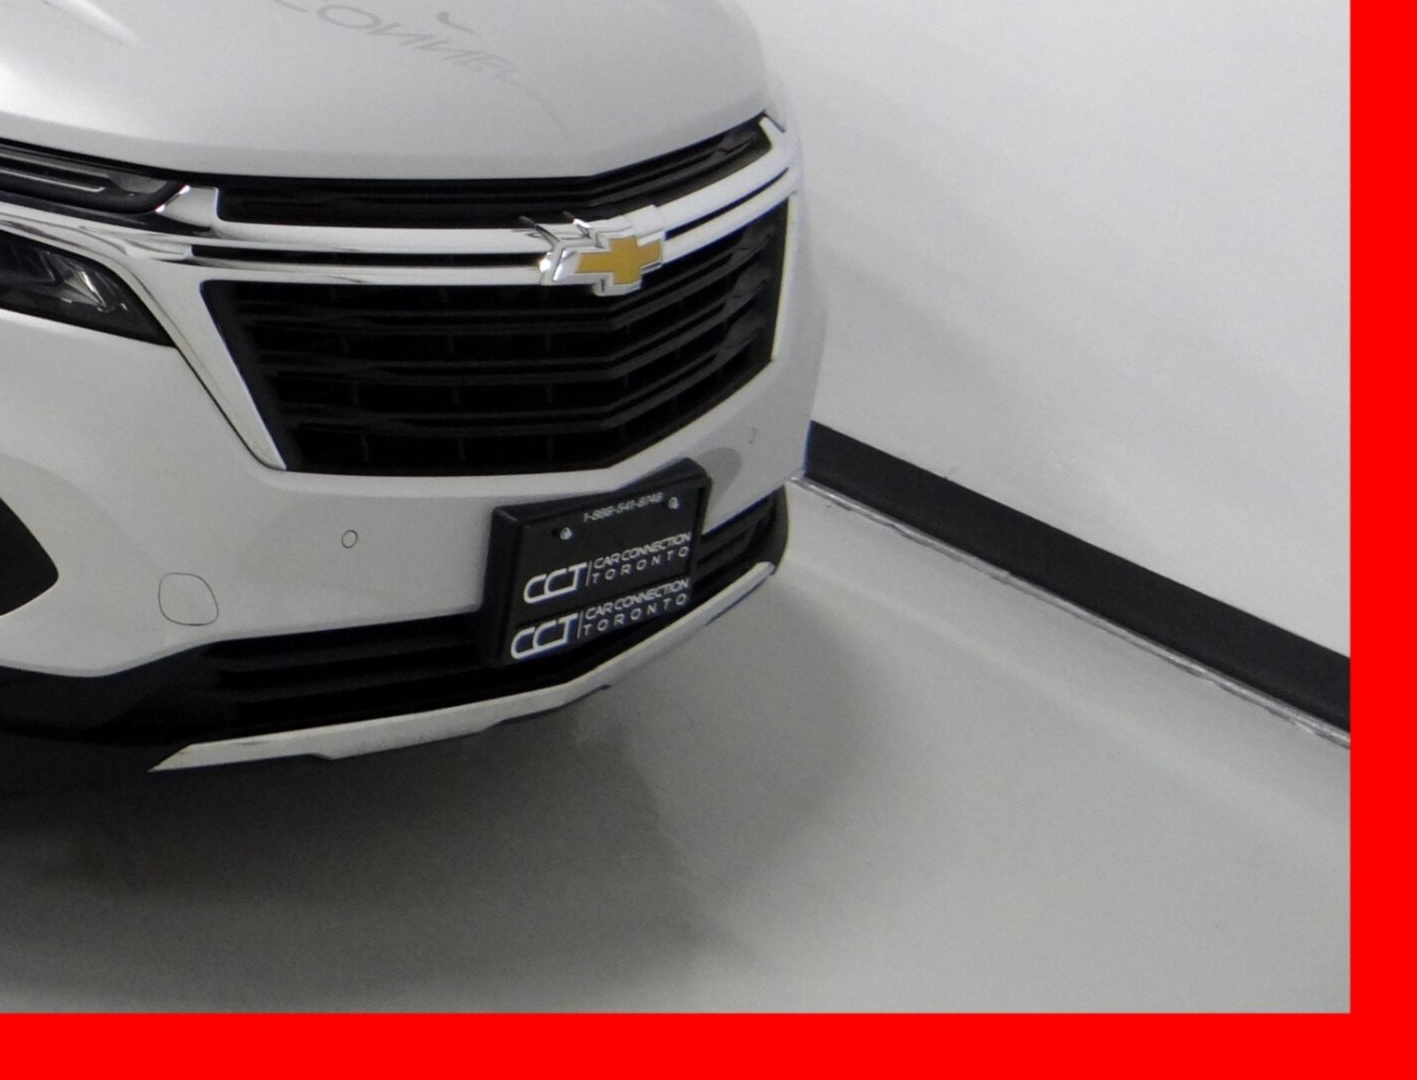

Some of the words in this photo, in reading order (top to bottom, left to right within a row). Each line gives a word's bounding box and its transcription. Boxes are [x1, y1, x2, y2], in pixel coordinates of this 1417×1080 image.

[591, 545, 689, 584] TORONTO
[593, 552, 620, 569] CAR
[620, 531, 691, 561] CONNECTION
[523, 562, 587, 604] CCT
[585, 602, 613, 620] CAR
[614, 578, 690, 610] CONNECTION
[583, 593, 688, 636] TORONTO
[510, 612, 579, 660] CCT
